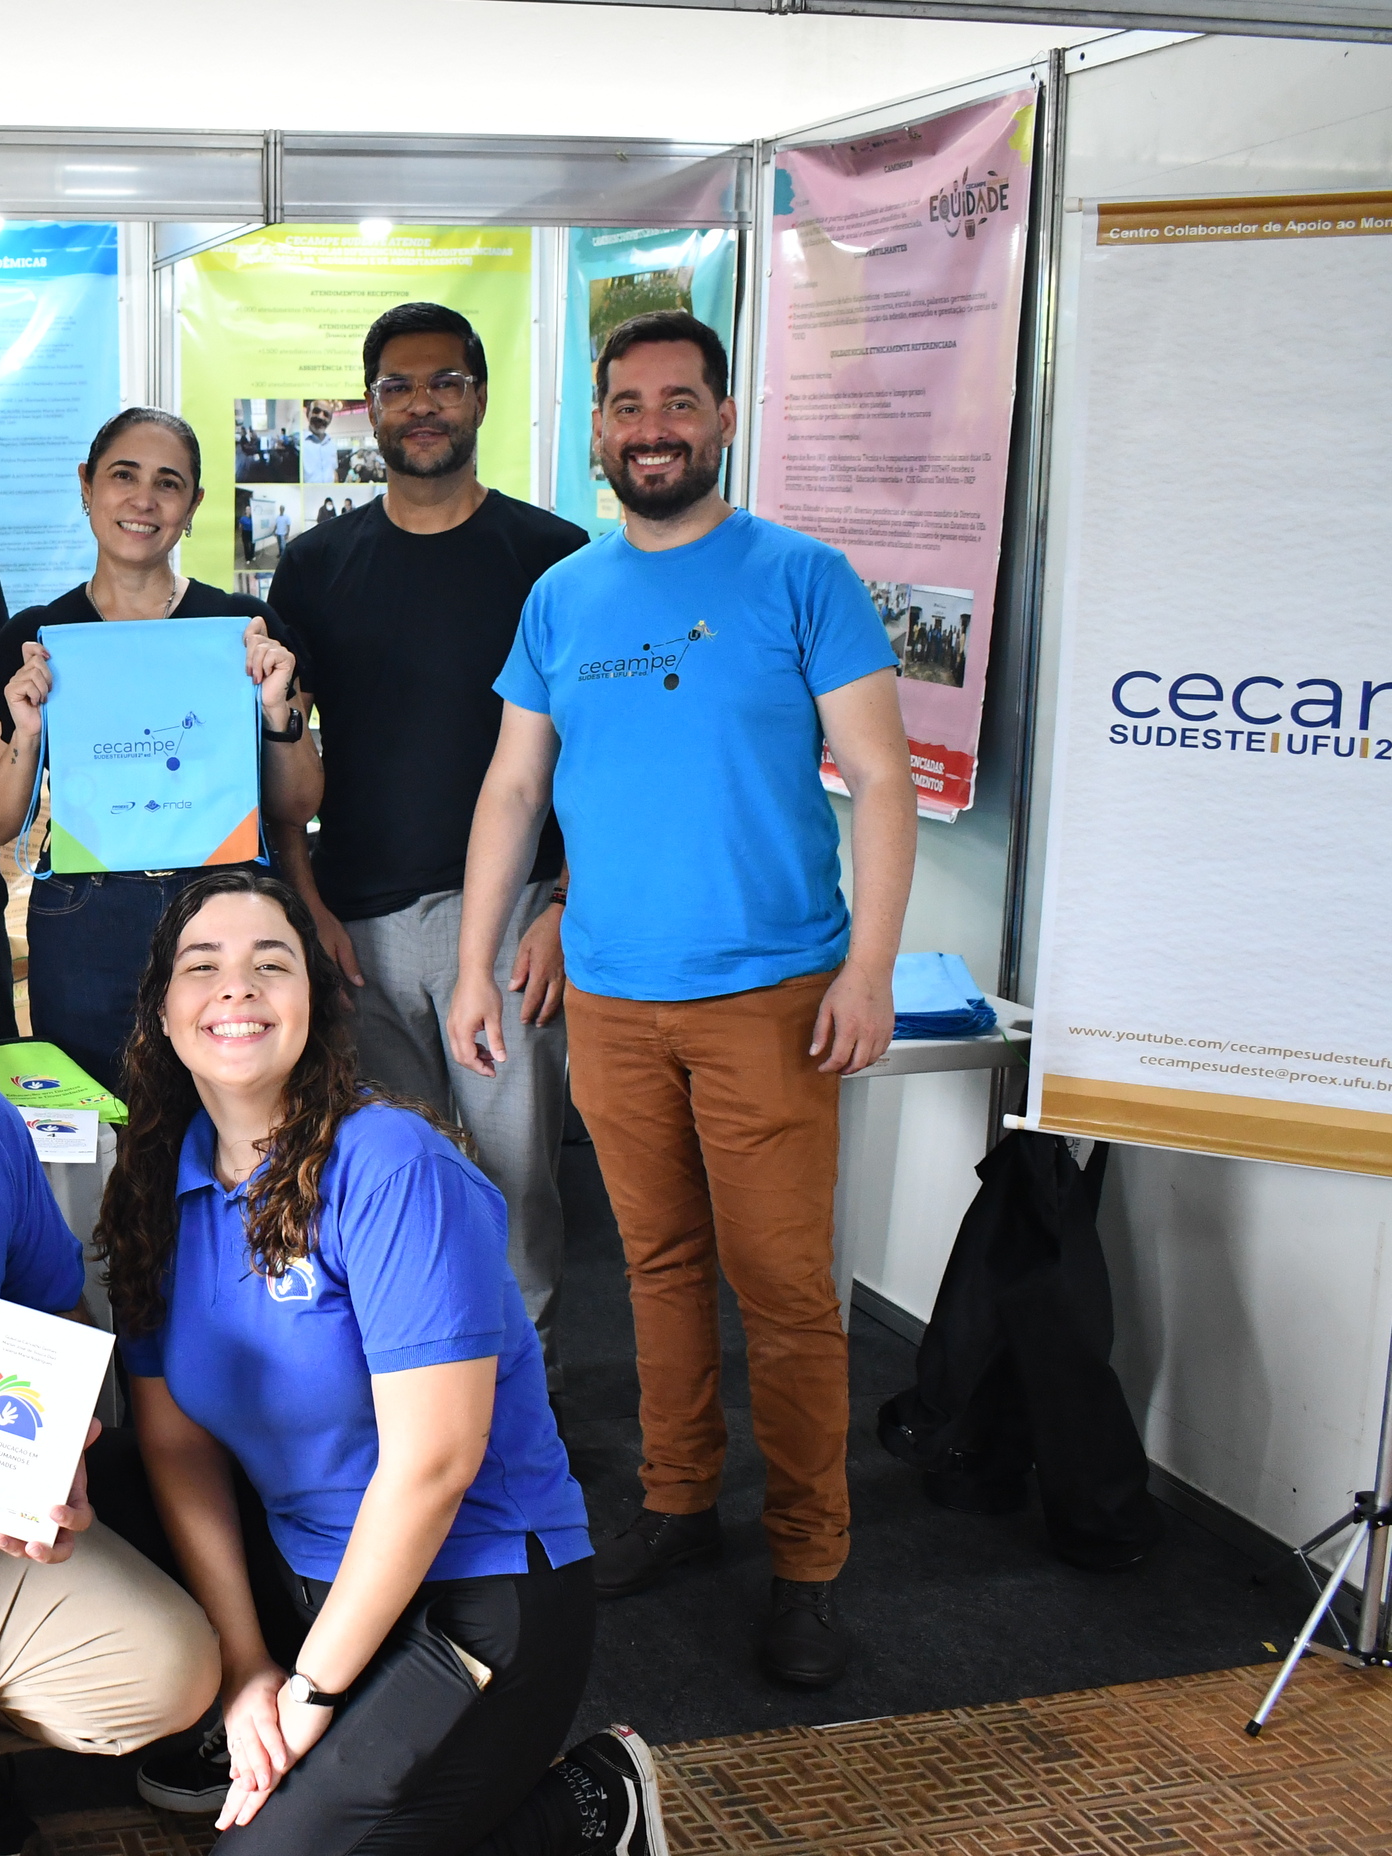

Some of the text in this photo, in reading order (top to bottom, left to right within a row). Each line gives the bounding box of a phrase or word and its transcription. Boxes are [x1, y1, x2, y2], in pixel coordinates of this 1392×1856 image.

[928, 183, 1010, 223] EQUIDADE
[1109, 226, 1159, 239] Centro
[1163, 222, 1258, 237] Colaborador
[1262, 221, 1282, 234] de
[1285, 217, 1332, 234] Apoio
[1336, 220, 1356, 230] ao
[579, 654, 676, 675] cecampe
[578, 672, 609, 682] SUDESTE
[613, 671, 628, 679] UFU
[93, 740, 176, 755] cecampe
[1108, 724, 1267, 753] SUDESTE
[1287, 733, 1356, 758] UFU
[910, 754, 945, 775] ENCIADAS:
[912, 772, 945, 792] AMENTOS
[1139, 1054, 1392, 1092] cecampesudeste@proex.ufu.br
[29, 1451, 39, 1459] EM
